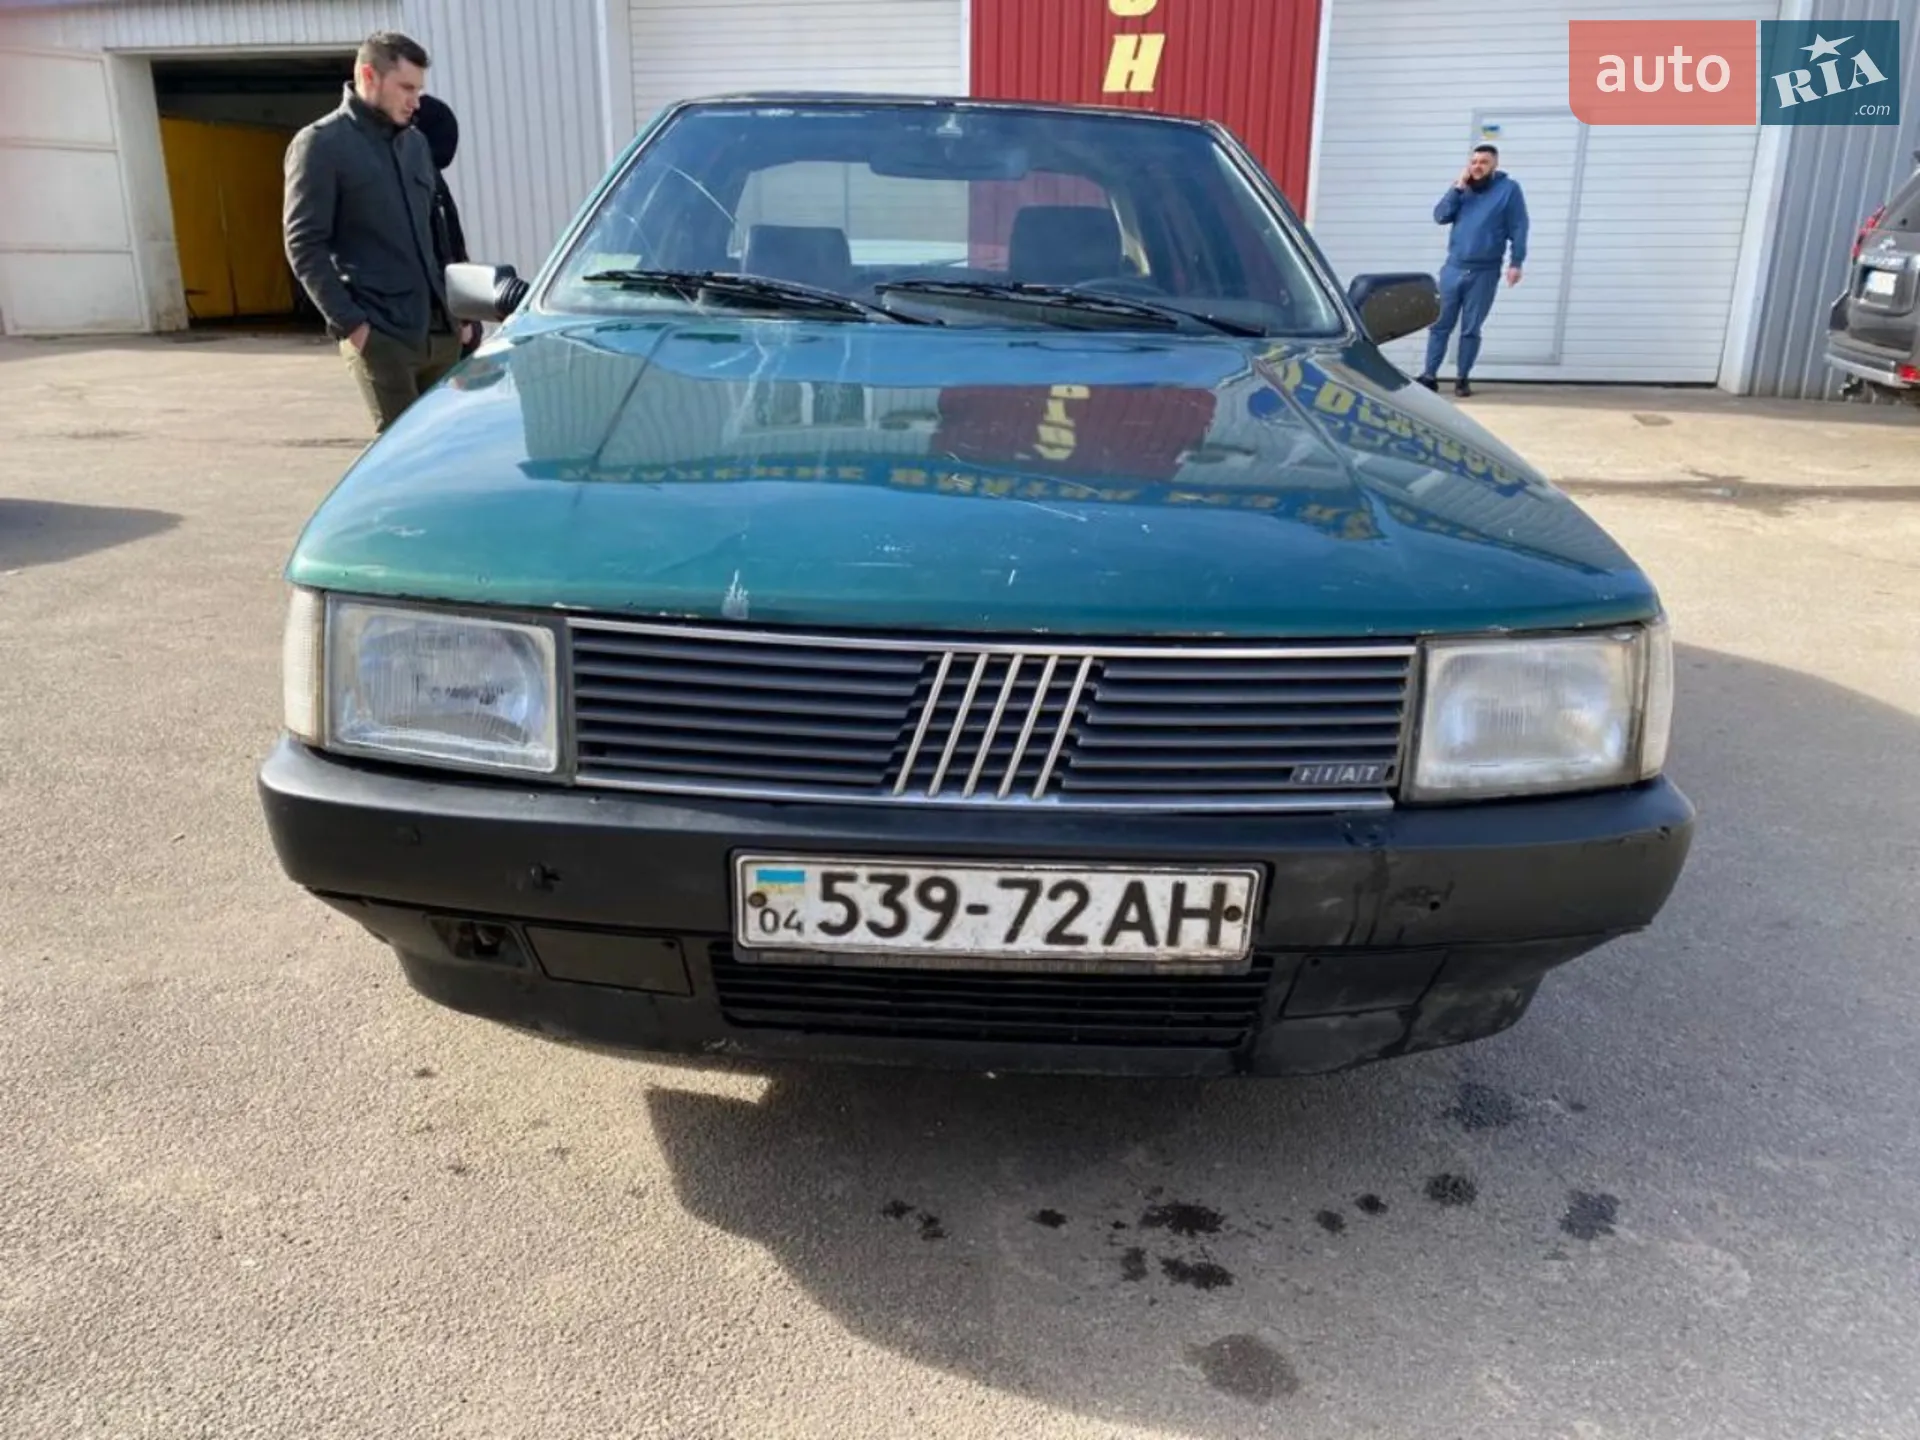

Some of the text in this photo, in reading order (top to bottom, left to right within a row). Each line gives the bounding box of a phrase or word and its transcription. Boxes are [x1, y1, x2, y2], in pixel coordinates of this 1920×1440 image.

[1300, 766, 1380, 781] FIAT
[758, 907, 802, 936] 04
[816, 871, 1089, 947] 539-72
